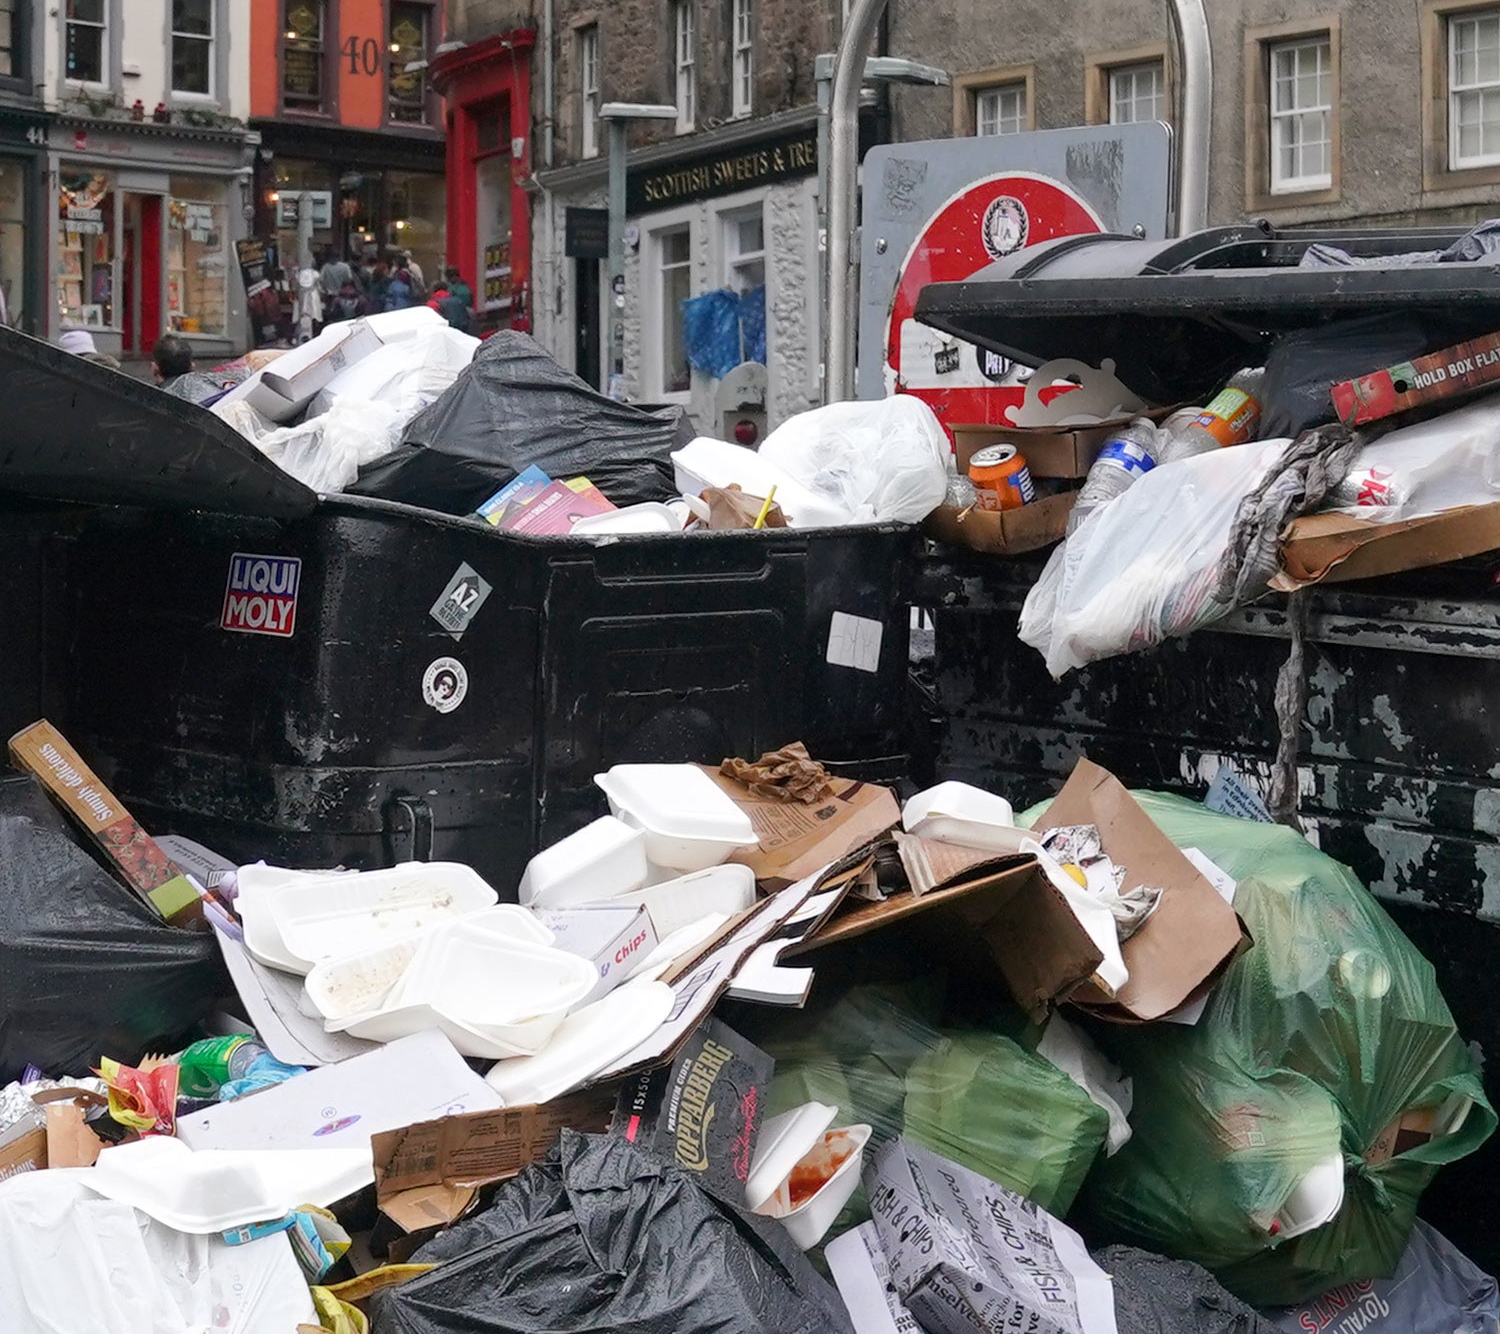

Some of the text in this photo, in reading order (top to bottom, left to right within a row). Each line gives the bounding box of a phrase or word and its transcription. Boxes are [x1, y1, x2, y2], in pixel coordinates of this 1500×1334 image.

[340, 35, 380, 77] 40
[26, 126, 46, 145] 44
[643, 165, 712, 202] SCOTTISH
[713, 149, 769, 186] SWEETS
[774, 147, 786, 173] &
[1413, 365, 1446, 390] HOLD
[1448, 355, 1475, 379] BOX
[231, 557, 297, 597] LIQUI
[450, 580, 480, 612] AZ
[226, 594, 294, 631] MOLY
[37, 743, 114, 823] Simply delicious
[614, 929, 648, 965] Chips
[667, 1057, 693, 1134] PREMIUM CIDER
[869, 1184, 935, 1256] FISH & CHIPS
[984, 1194, 1026, 1251] CHIPS
[1014, 1254, 1036, 1269] &
[1027, 1264, 1066, 1305] FISH
